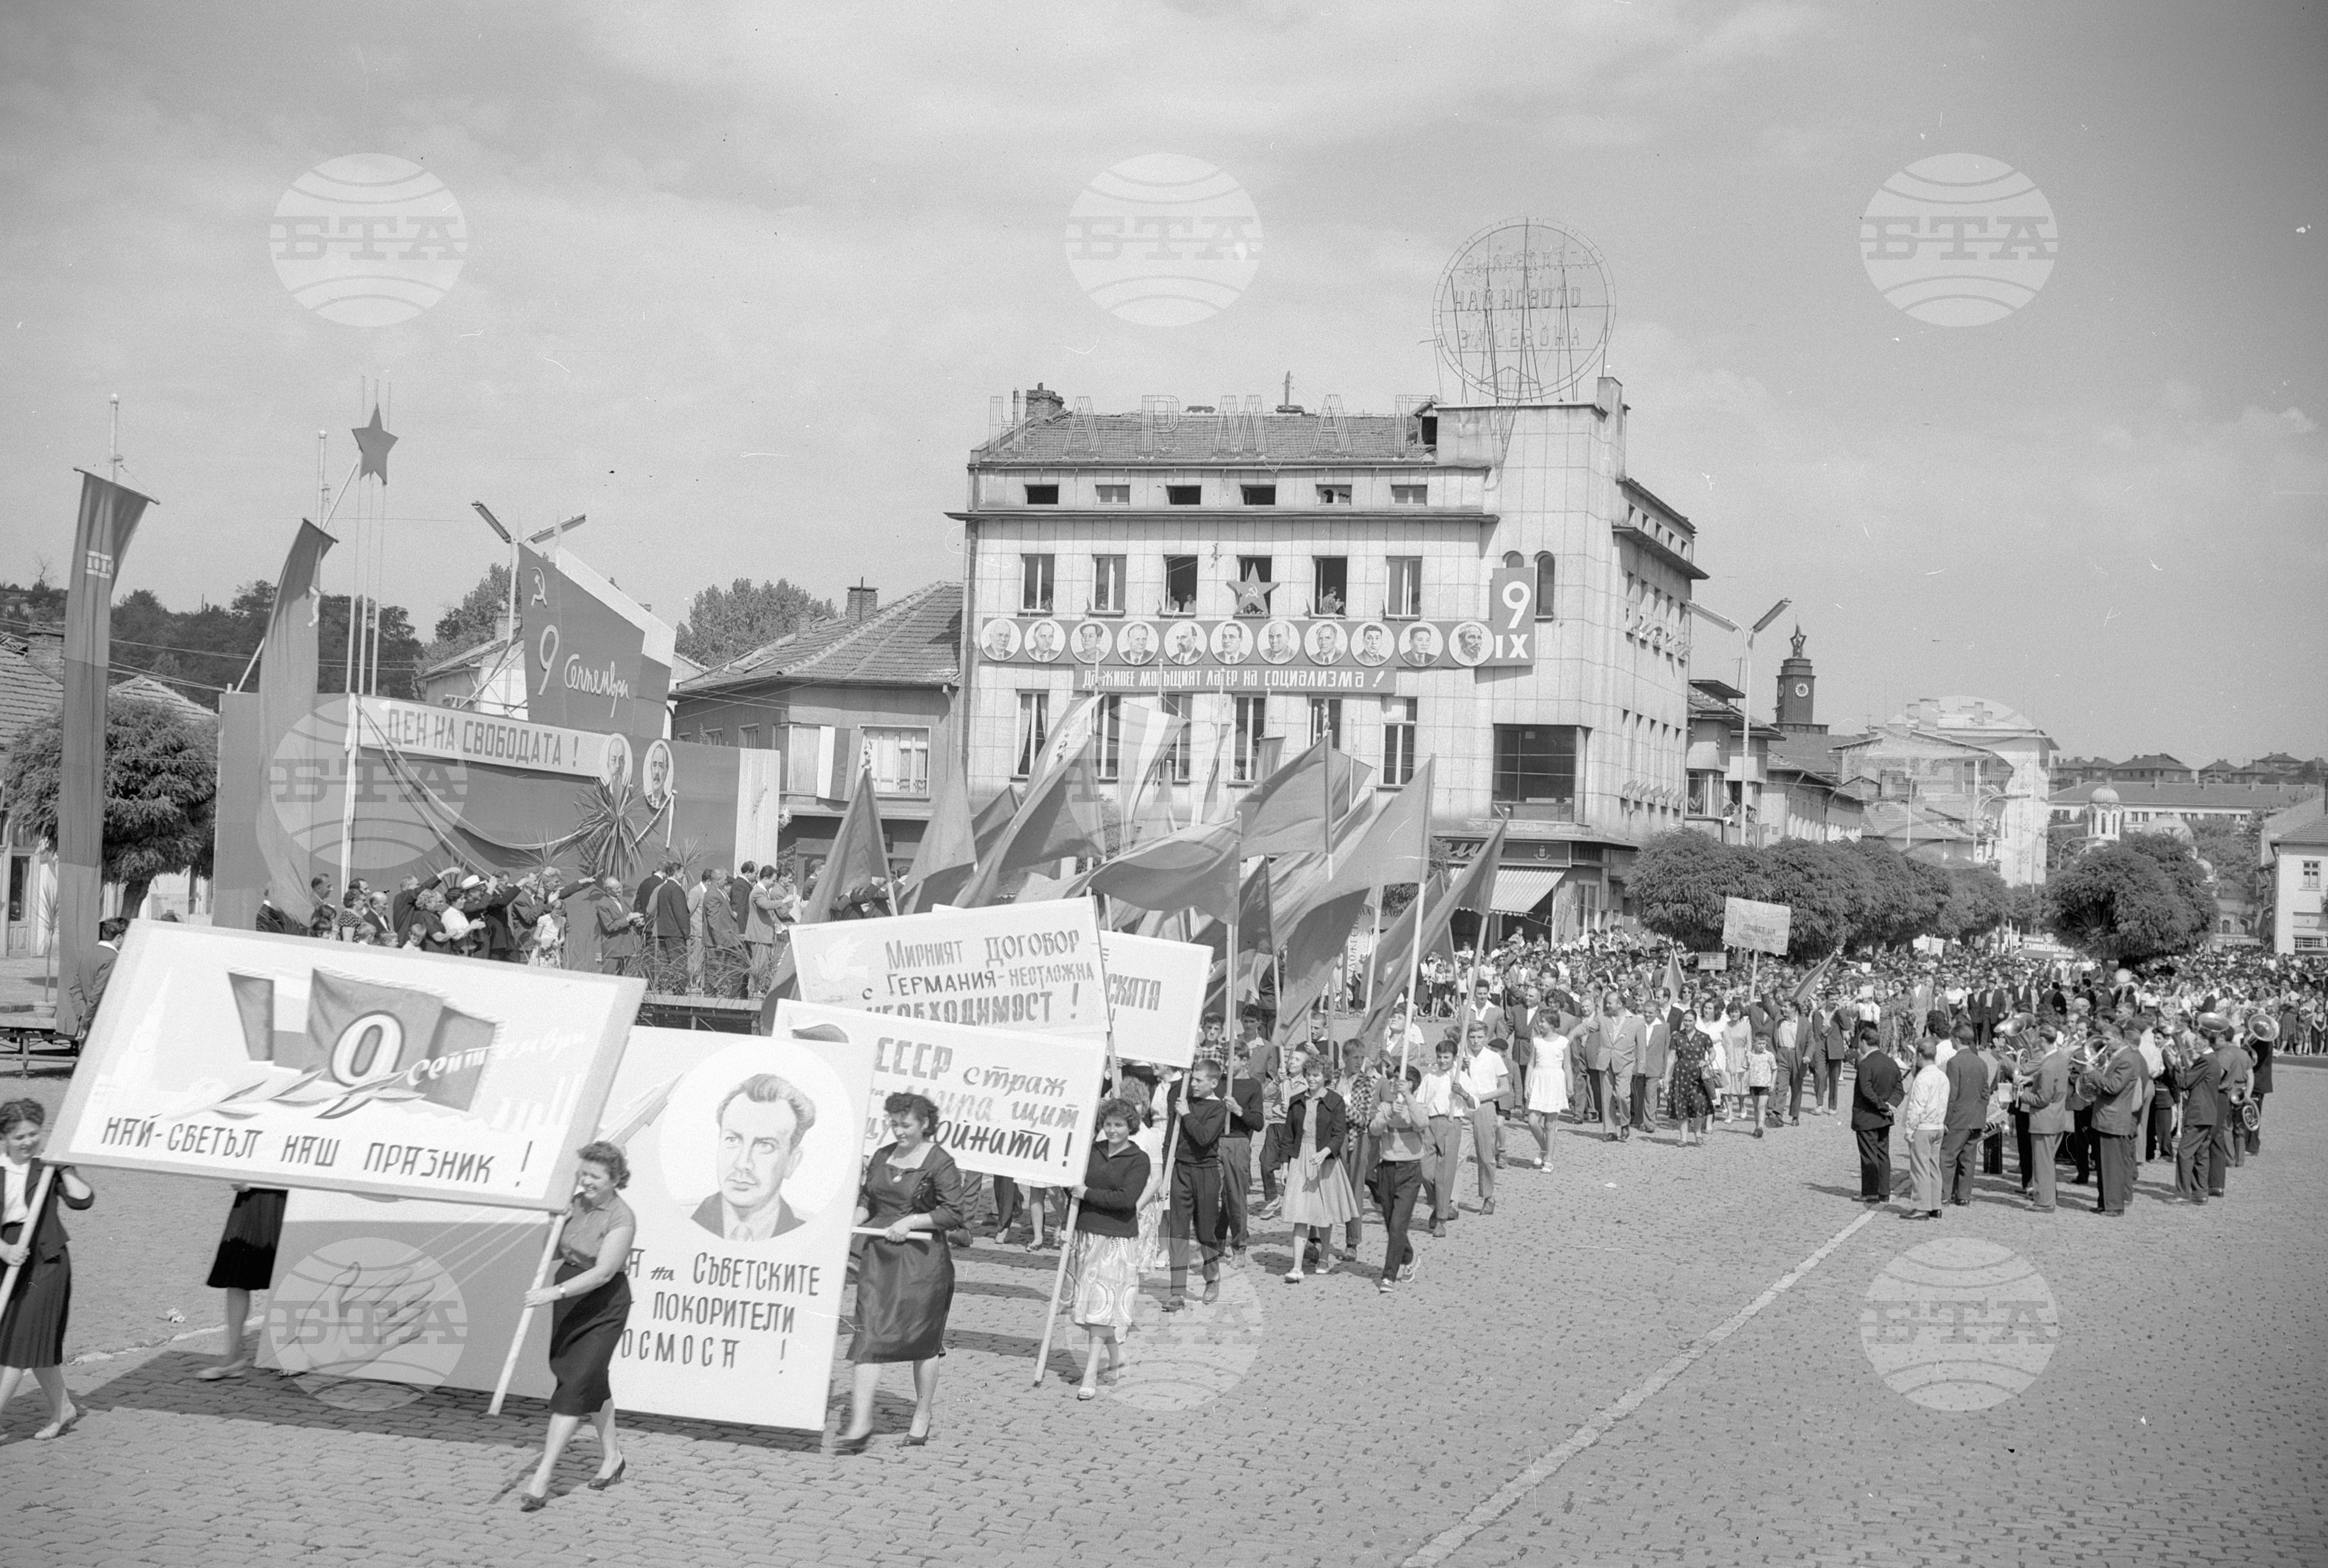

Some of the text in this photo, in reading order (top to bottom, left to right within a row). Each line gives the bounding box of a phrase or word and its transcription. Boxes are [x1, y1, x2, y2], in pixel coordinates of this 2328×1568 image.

[1502, 580, 1531, 629] 9
[537, 625, 560, 696] 9
[1139, 670, 1202, 689] МОЪЩИЯТ
[1206, 670, 1238, 686] ЛАЕР
[388, 708, 428, 748] ДЕН
[434, 714, 456, 751] НА
[463, 719, 562, 766] СВОБОДАТА
[1106, 973, 1162, 1011] СКАТА
[874, 1037, 953, 1080] СССР
[281, 1135, 342, 1167] НАШ
[363, 1141, 495, 1184] ПРАЗНИК
[934, 1119, 1052, 1162] ойната
[652, 1291, 796, 1333] ПОКОРИТЕЛИ
[620, 1328, 741, 1369] ОСМОСА
